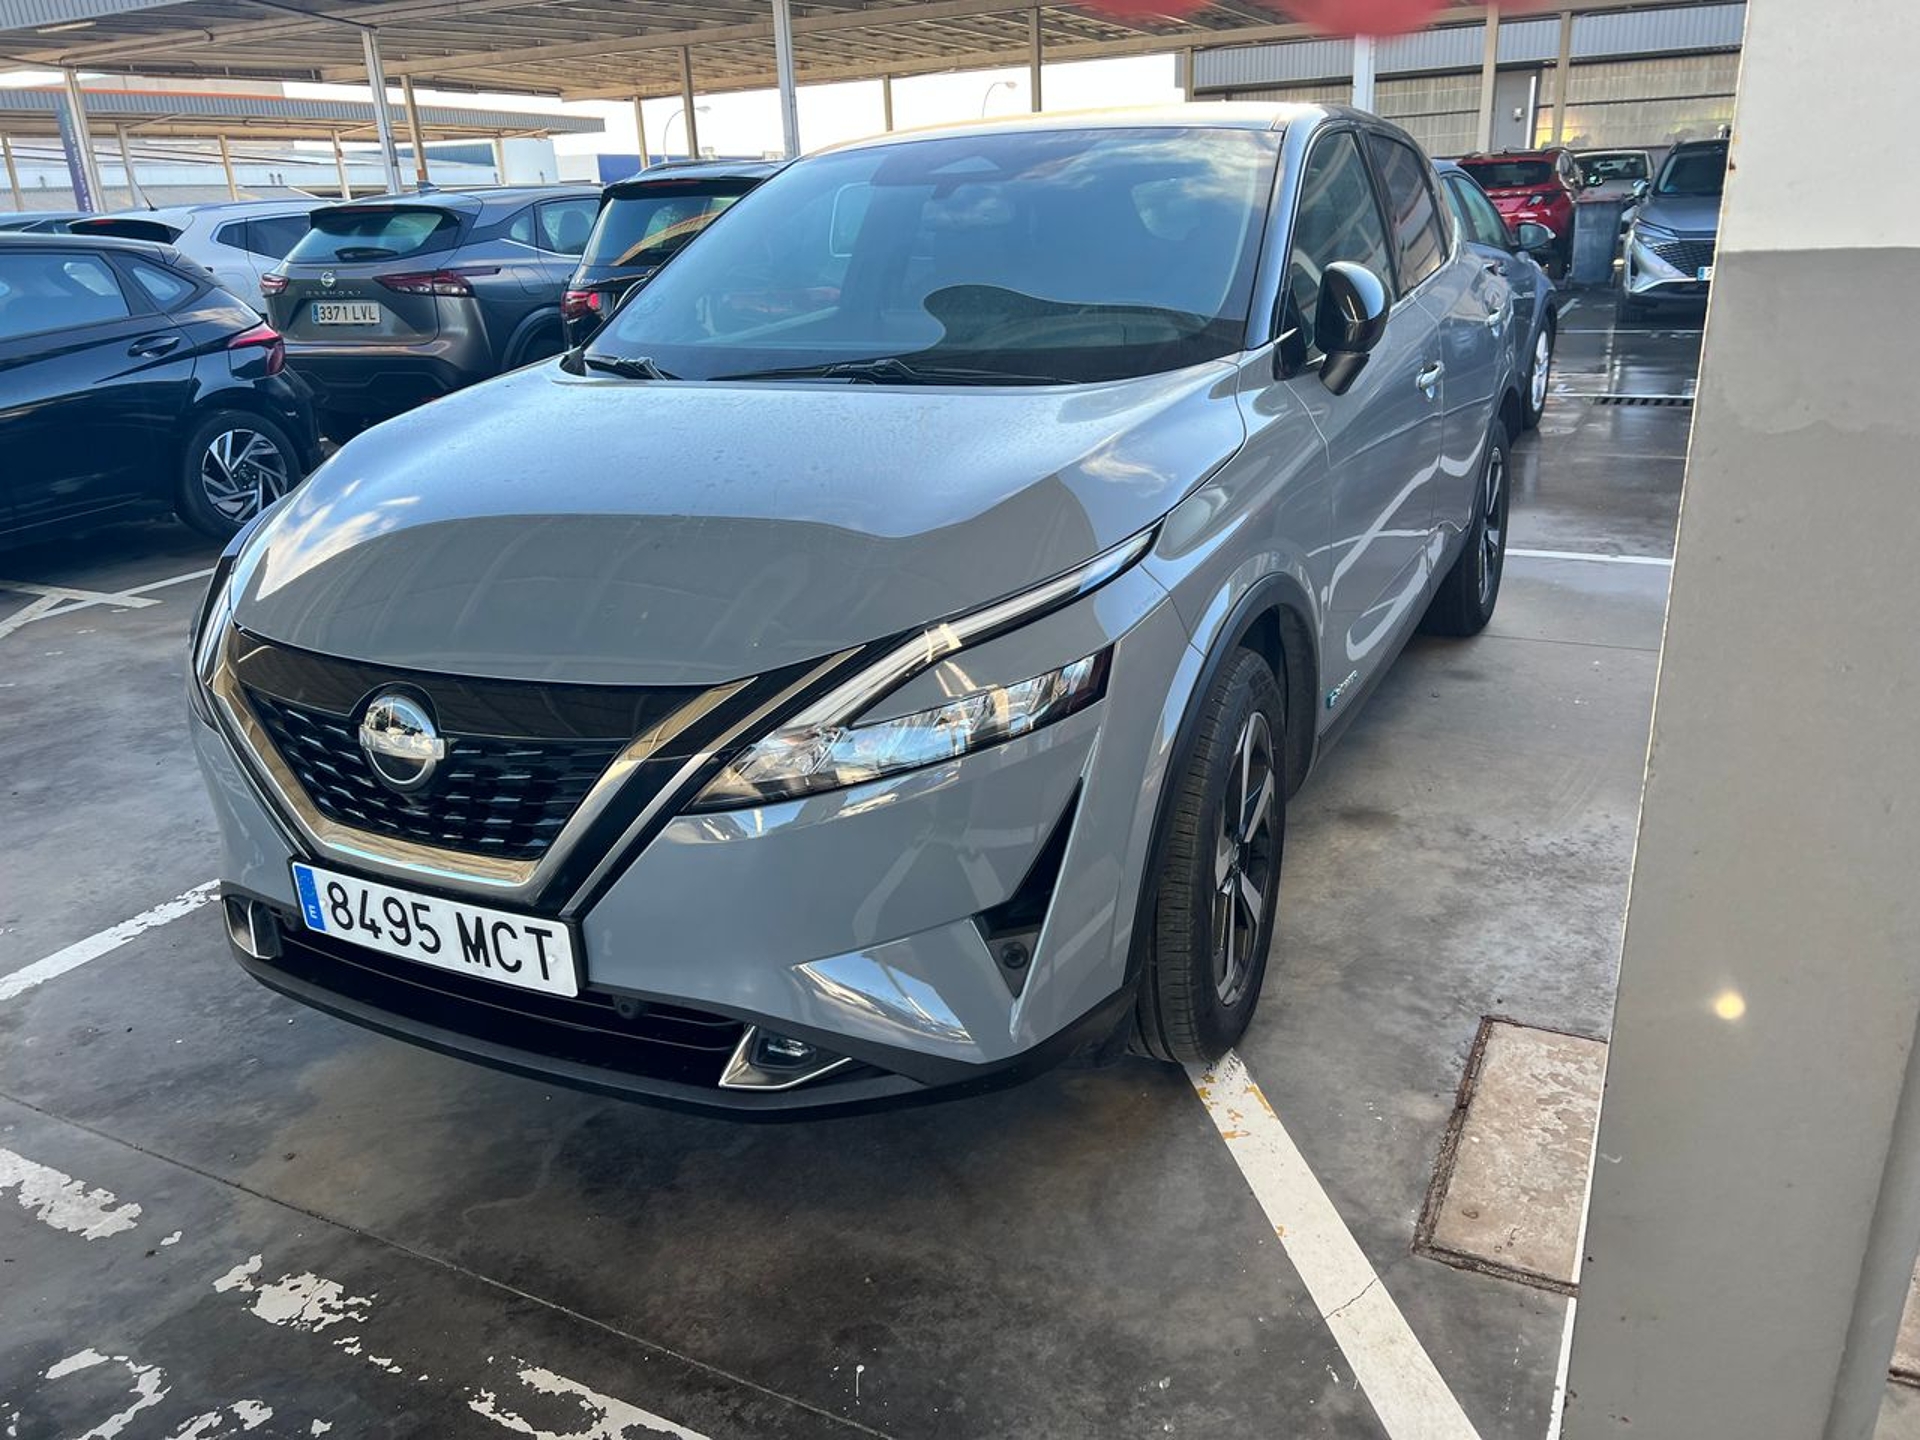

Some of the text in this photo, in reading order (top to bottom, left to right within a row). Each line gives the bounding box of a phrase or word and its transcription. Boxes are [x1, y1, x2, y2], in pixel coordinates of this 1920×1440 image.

[319, 306, 348, 321] 3371
[309, 904, 318, 919] E
[327, 881, 553, 981] 8495 MCT
